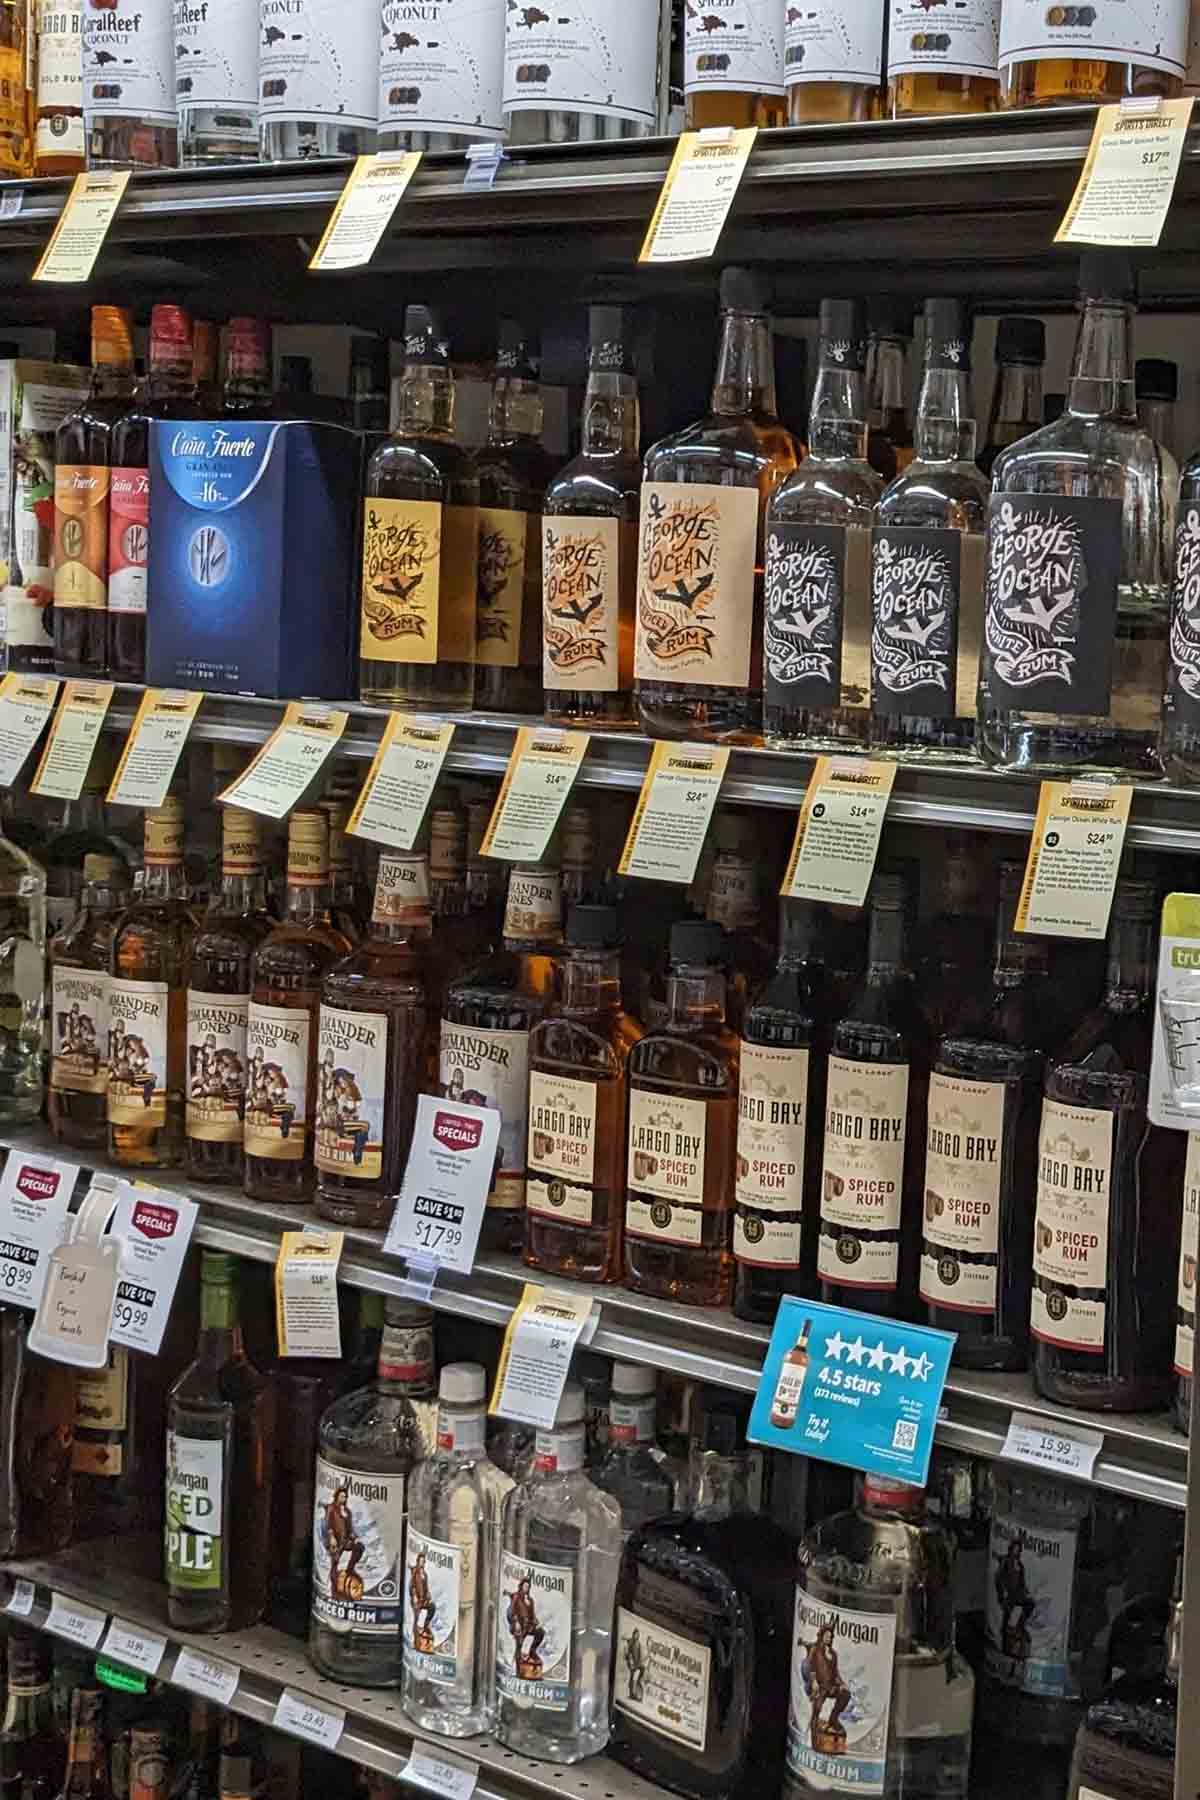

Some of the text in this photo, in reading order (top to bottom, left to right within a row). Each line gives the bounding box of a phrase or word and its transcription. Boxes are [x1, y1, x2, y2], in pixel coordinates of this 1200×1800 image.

[171, 430, 256, 458] Caña Fuerte
[642, 512, 714, 556] GEORGE
[989, 521, 1076, 580] GEORGE
[369, 551, 424, 578] OCEAN
[649, 544, 714, 581] OCEAN
[766, 552, 830, 595] GEORGE
[874, 555, 946, 602] GEORGE
[998, 557, 1075, 600] OCEAN
[549, 570, 602, 602] OCEAN
[770, 579, 830, 615] OCEAN
[881, 585, 944, 622] OCEAN
[384, 616, 414, 634] RUM
[666, 630, 700, 652] RUM
[990, 623, 1024, 654] WHITE
[564, 642, 593, 662] RUM
[786, 658, 819, 679] RUM
[900, 665, 934, 686] RUM
[1017, 655, 1057, 678] RUM
[1061, 796, 1118, 810] SPIRITS DIRECT
[1109, 817, 1122, 825] Rum
[112, 1006, 138, 1022] ONES
[321, 1031, 350, 1051] ONES
[739, 1095, 802, 1126] ARGO BAY
[531, 1104, 592, 1139] LARGO BAY
[870, 1117, 902, 1142] BAY
[437, 1125, 478, 1145] SPECIALS
[631, 1124, 701, 1160] LARGO BAY
[556, 1136, 588, 1156] SPICED
[965, 1134, 998, 1163] BAY
[561, 1153, 580, 1167] RUM
[659, 1158, 697, 1176] SPICED
[752, 1159, 796, 1176] SPICED
[19, 1177, 54, 1195] SPECIALS
[666, 1173, 688, 1188] RUM
[759, 1174, 786, 1189] RUM
[848, 1178, 896, 1194] SPICED
[1073, 1165, 1105, 1194] BAY
[415, 1198, 443, 1217] SAVE
[856, 1192, 885, 1207] RUM
[947, 1198, 991, 1216] SPICED
[135, 1214, 173, 1234] SPECIALS
[955, 1212, 981, 1229] RUM
[1055, 1229, 1099, 1249] SPICED
[1061, 1245, 1089, 1262] RUM
[818, 1366, 882, 1396] 4.5 stars
[808, 1413, 821, 1430] Try
[343, 1475, 388, 1503] Morgan
[421, 1543, 453, 1569] Morgan
[528, 1567, 565, 1593] Morgan
[348, 1608, 377, 1625] RUM
[826, 1612, 880, 1645] Morgan
[528, 1682, 554, 1700] RUM
[826, 1759, 861, 1781] RUM
